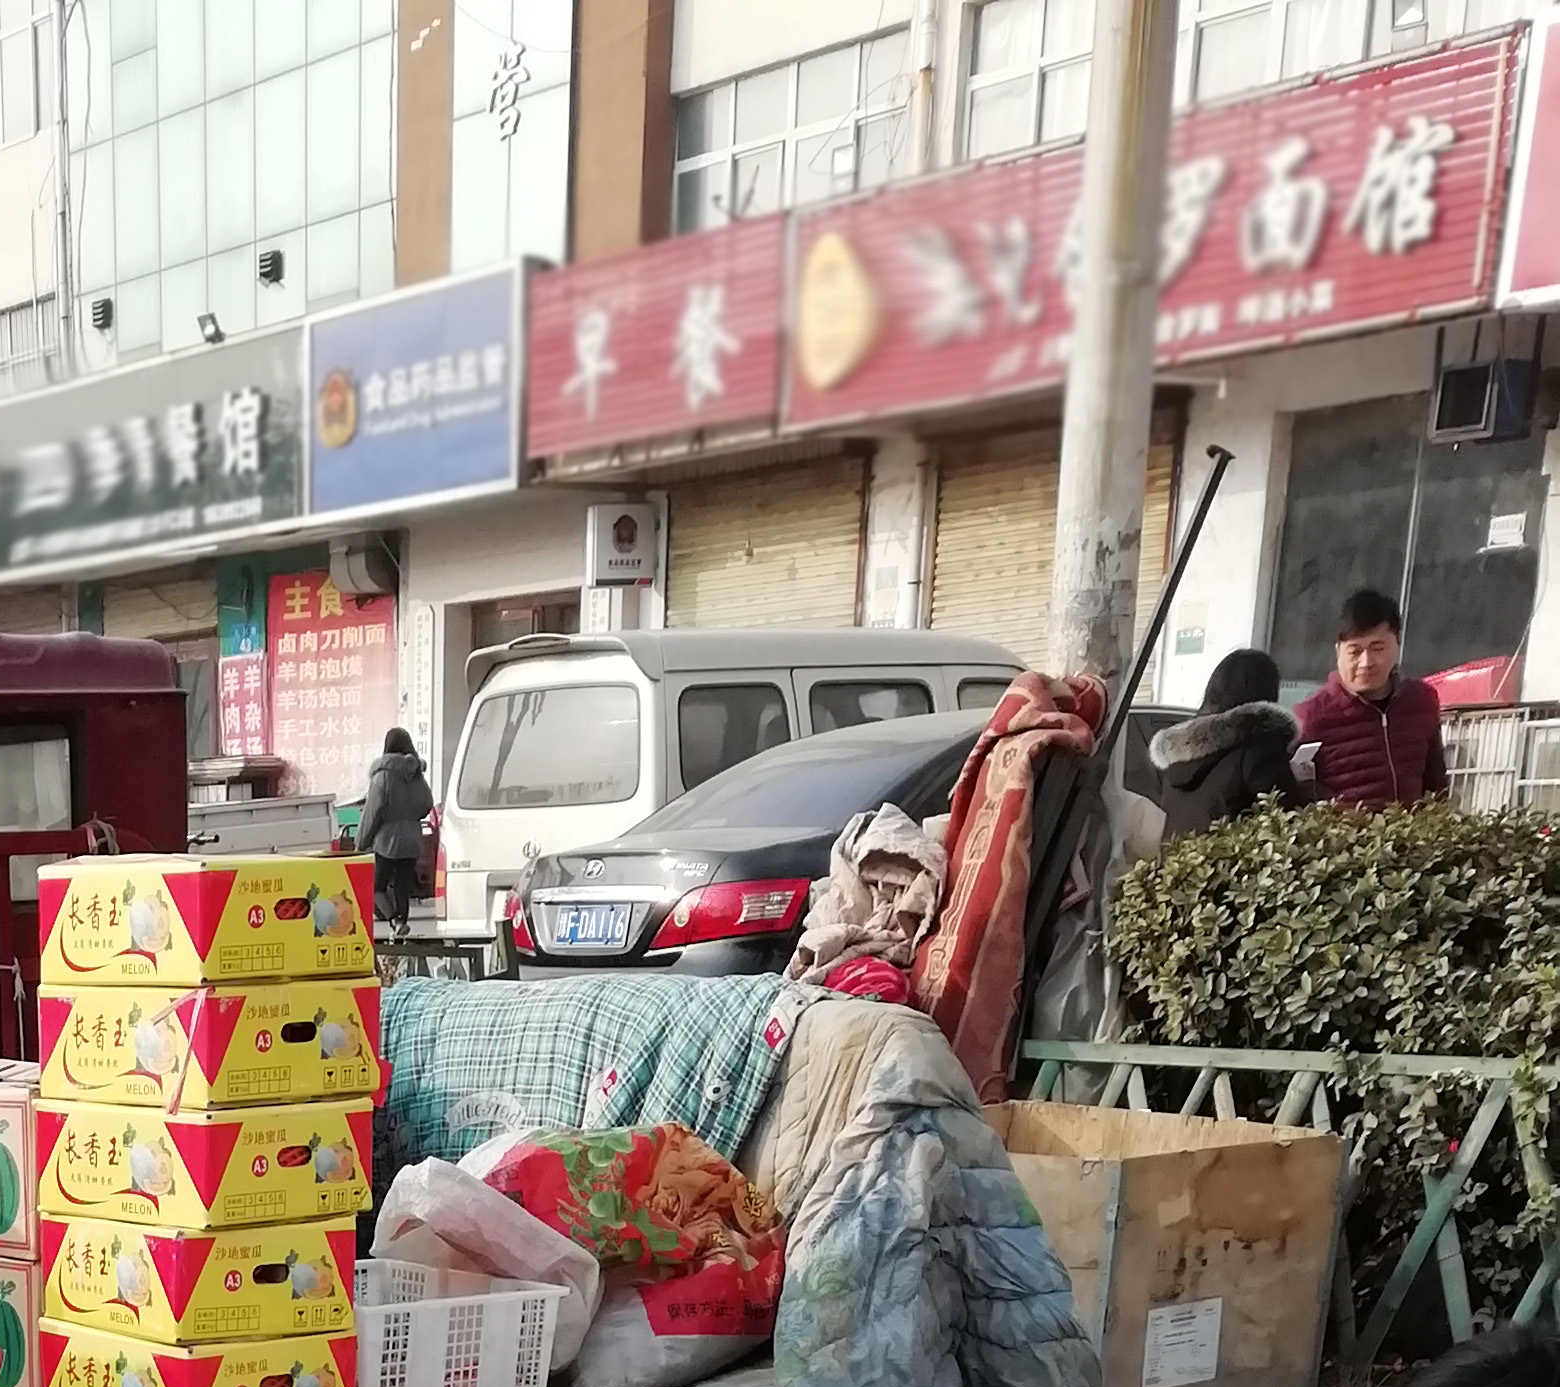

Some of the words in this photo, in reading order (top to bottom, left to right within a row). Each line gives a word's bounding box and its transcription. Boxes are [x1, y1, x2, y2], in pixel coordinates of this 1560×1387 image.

[283, 577, 345, 621] 主食
[278, 623, 387, 654] 卤肉刀削面
[277, 655, 363, 683] 羊肉泡馍
[277, 685, 361, 712] 羊汤烩面
[277, 714, 363, 740] 手工水饺
[69, 891, 122, 933] 长香玉
[249, 908, 264, 925] A3
[121, 963, 150, 975] MELON
[72, 1013, 127, 1051] 长香玉
[257, 1034, 272, 1049] A3
[126, 1083, 157, 1096] MELON
[65, 1129, 122, 1169] 长香玉
[253, 1159, 268, 1174] A3
[121, 1202, 153, 1216] MELON
[66, 1238, 111, 1278] 长香玉
[226, 1273, 241, 1288] A3
[109, 1311, 135, 1326] MELON
